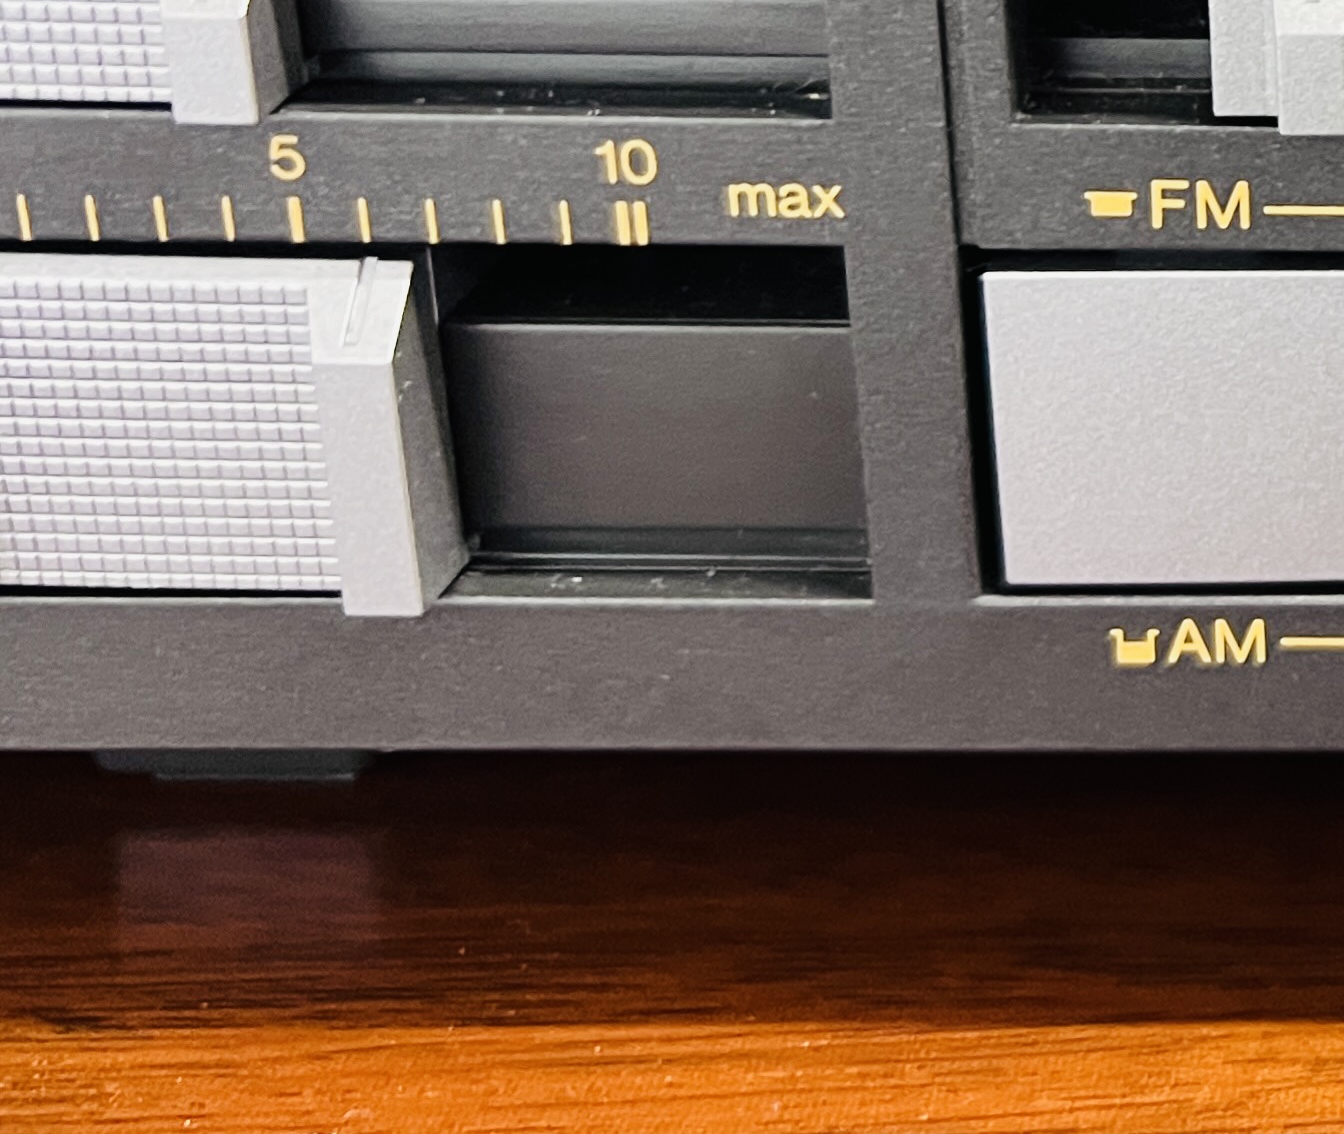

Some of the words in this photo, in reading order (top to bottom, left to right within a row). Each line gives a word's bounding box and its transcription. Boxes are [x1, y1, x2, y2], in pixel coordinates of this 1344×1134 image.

[269, 134, 306, 182] 5
[596, 139, 657, 187] 10
[728, 180, 844, 221] max
[1150, 179, 1252, 230] FM
[1167, 618, 1267, 664] AM
